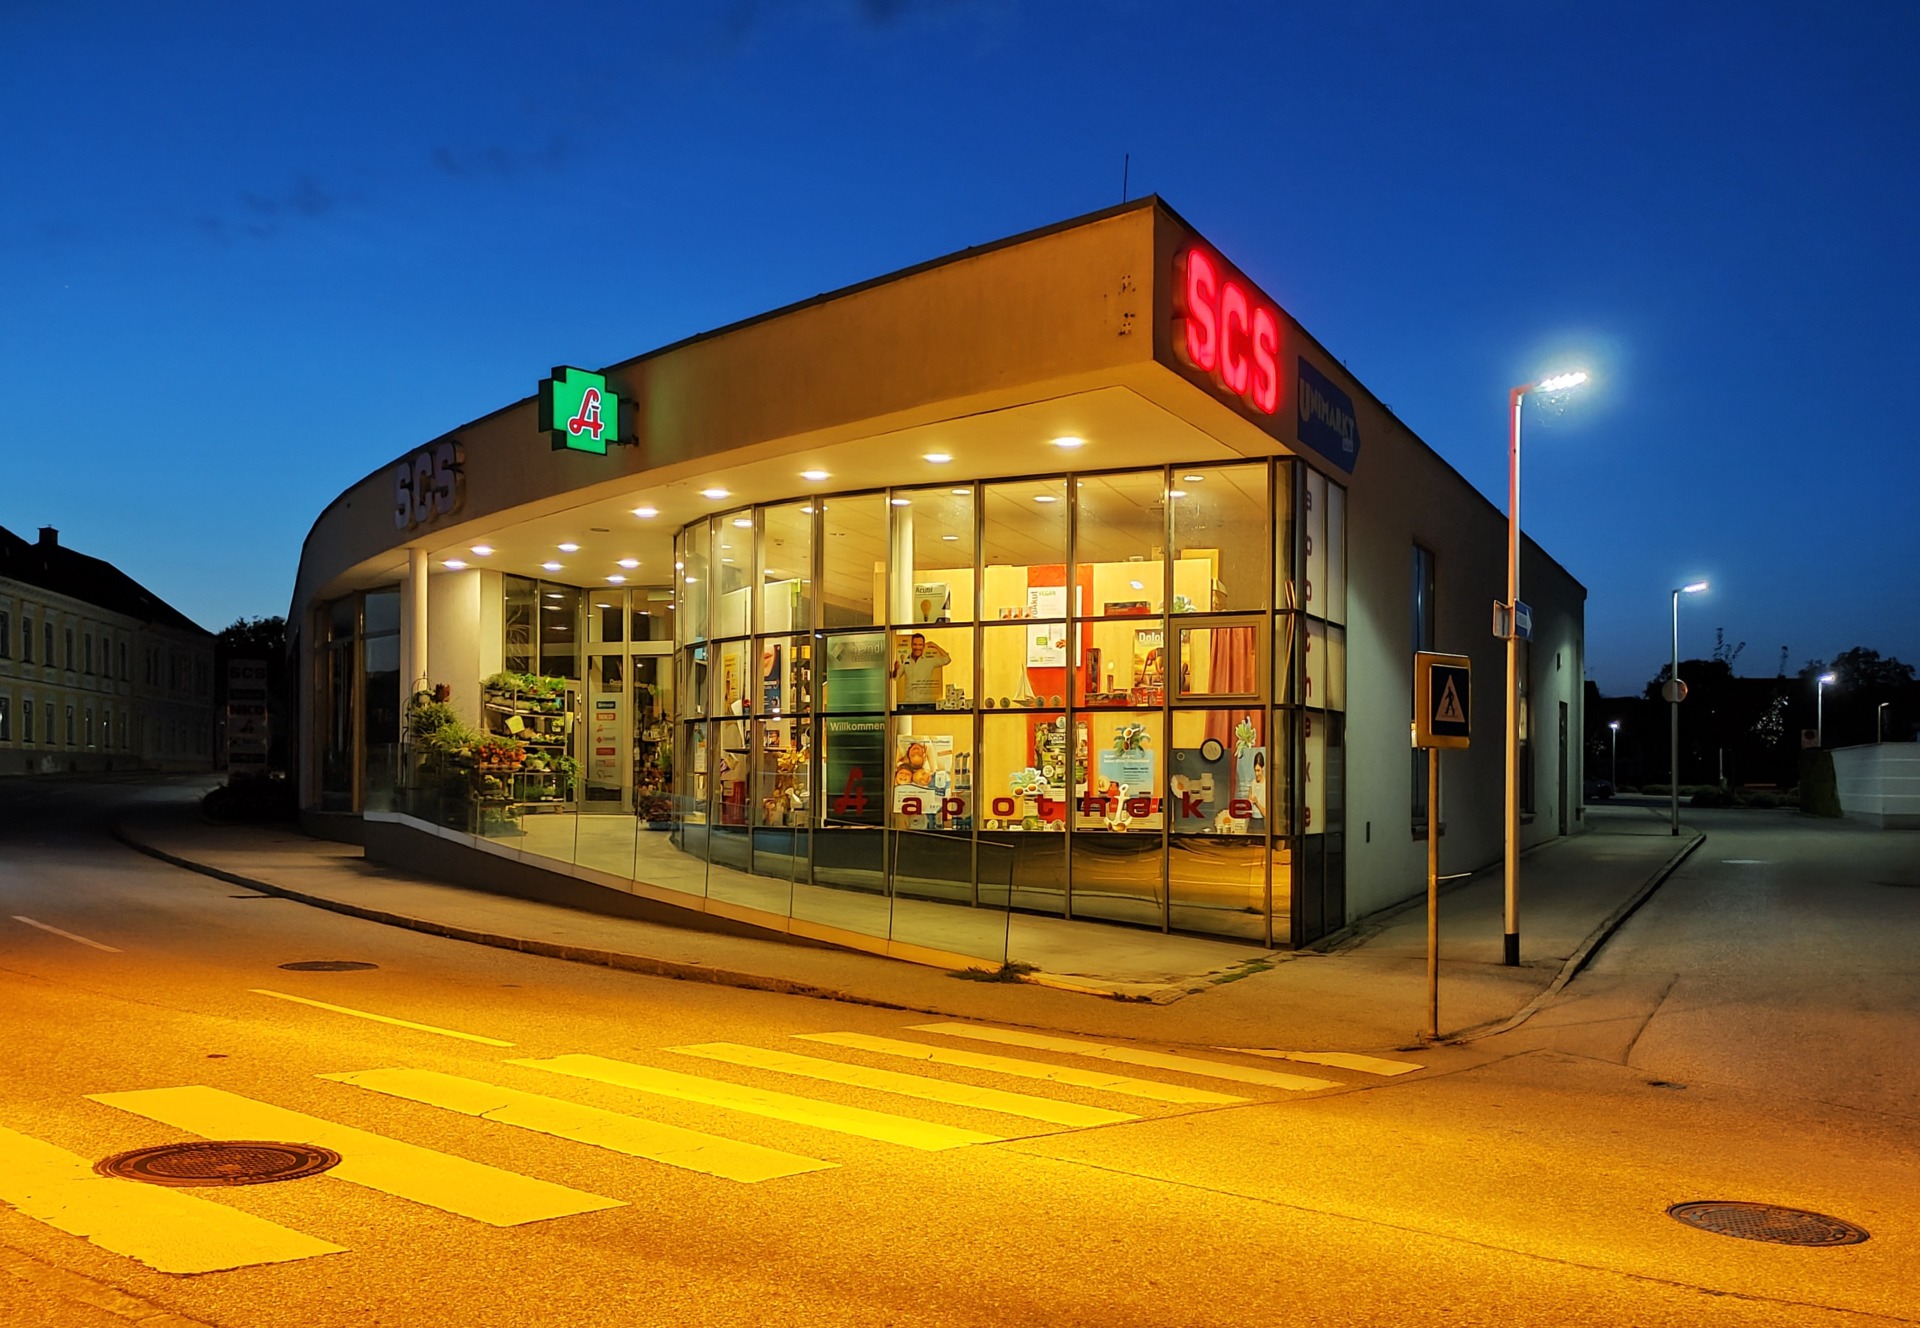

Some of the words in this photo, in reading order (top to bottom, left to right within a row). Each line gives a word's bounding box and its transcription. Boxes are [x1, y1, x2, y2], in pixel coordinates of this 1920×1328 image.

[1187, 249, 1278, 415] SCS
[1299, 377, 1355, 439] UNIMARKT
[394, 442, 458, 530] SCS
[1030, 591, 1038, 619] roAkut
[230, 667, 265, 679] SCS
[829, 721, 885, 732] Willkommen
[902, 790, 1253, 822] apotheke
